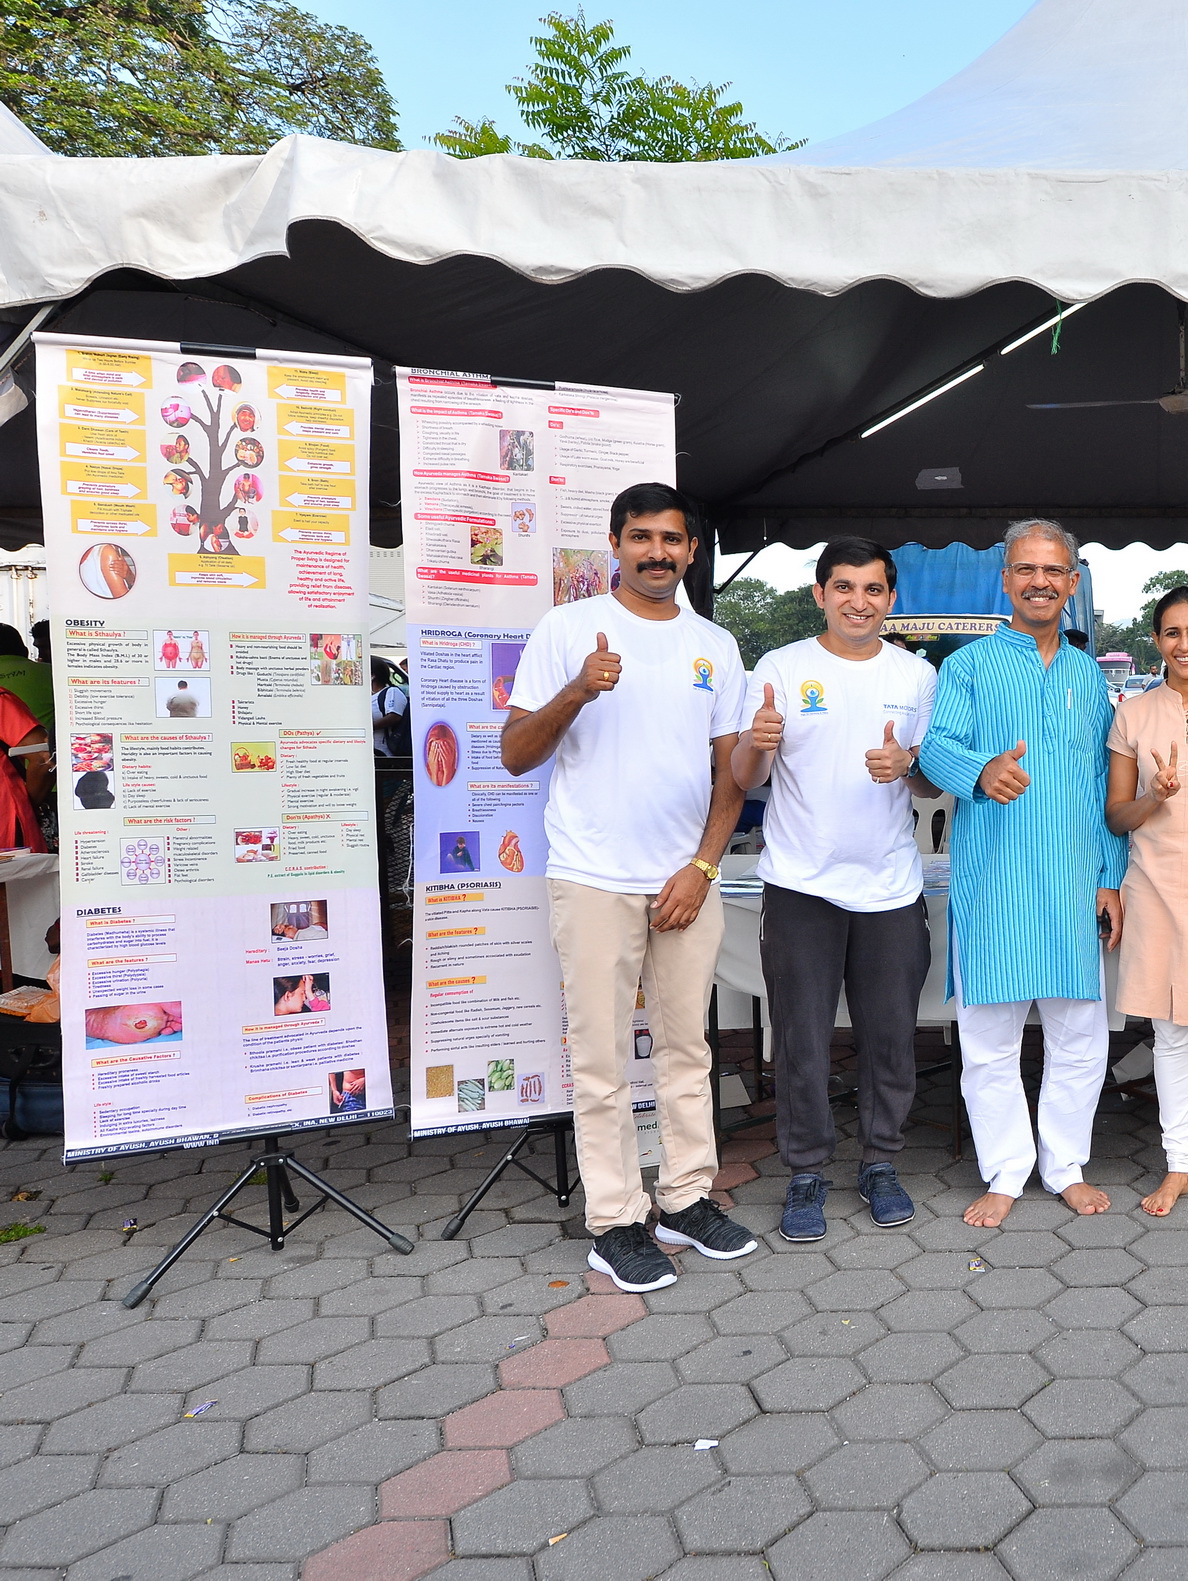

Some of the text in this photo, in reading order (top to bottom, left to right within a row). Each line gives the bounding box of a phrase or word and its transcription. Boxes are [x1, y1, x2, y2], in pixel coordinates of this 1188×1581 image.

[411, 368, 459, 376] BRONCHIAL
[65, 619, 105, 627] OBESITY
[900, 622, 934, 631] MAJU
[938, 622, 1000, 631] CATERERS
[421, 629, 462, 637] HRIDROGA
[465, 632, 501, 640] (Coronary
[426, 882, 501, 892] KITIBHA (PSORIASIS)
[76, 906, 122, 916] DIABETES
[248, 1093, 281, 1101] Complications
[337, 1114, 357, 1122] DELHI
[367, 1109, 393, 1117] 110023
[414, 1128, 446, 1137] MINISTRY
[482, 1121, 504, 1129] AYUSH
[66, 1149, 107, 1157] MINISTRY
